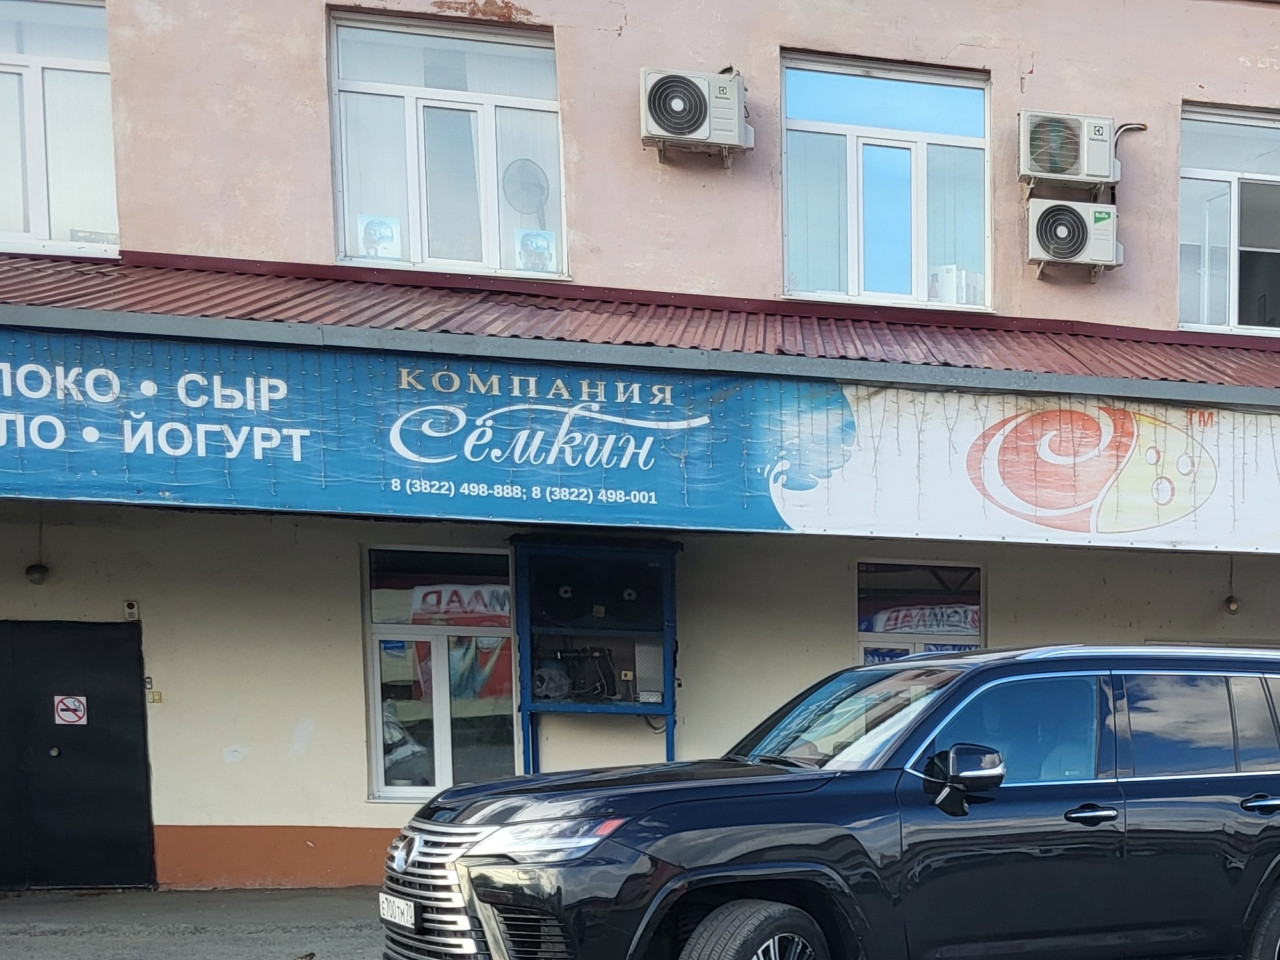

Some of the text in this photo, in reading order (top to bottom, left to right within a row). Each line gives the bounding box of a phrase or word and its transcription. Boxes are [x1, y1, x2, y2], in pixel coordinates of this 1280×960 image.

[177, 374, 288, 411] СЫР
[398, 367, 674, 406] КОМПАНИЯ
[123, 411, 311, 462] ЙОГУРТ
[1186, 408, 1214, 428] TM
[391, 478, 658, 504] 8 (3822) 498-888; 8 (3822) 498-001
